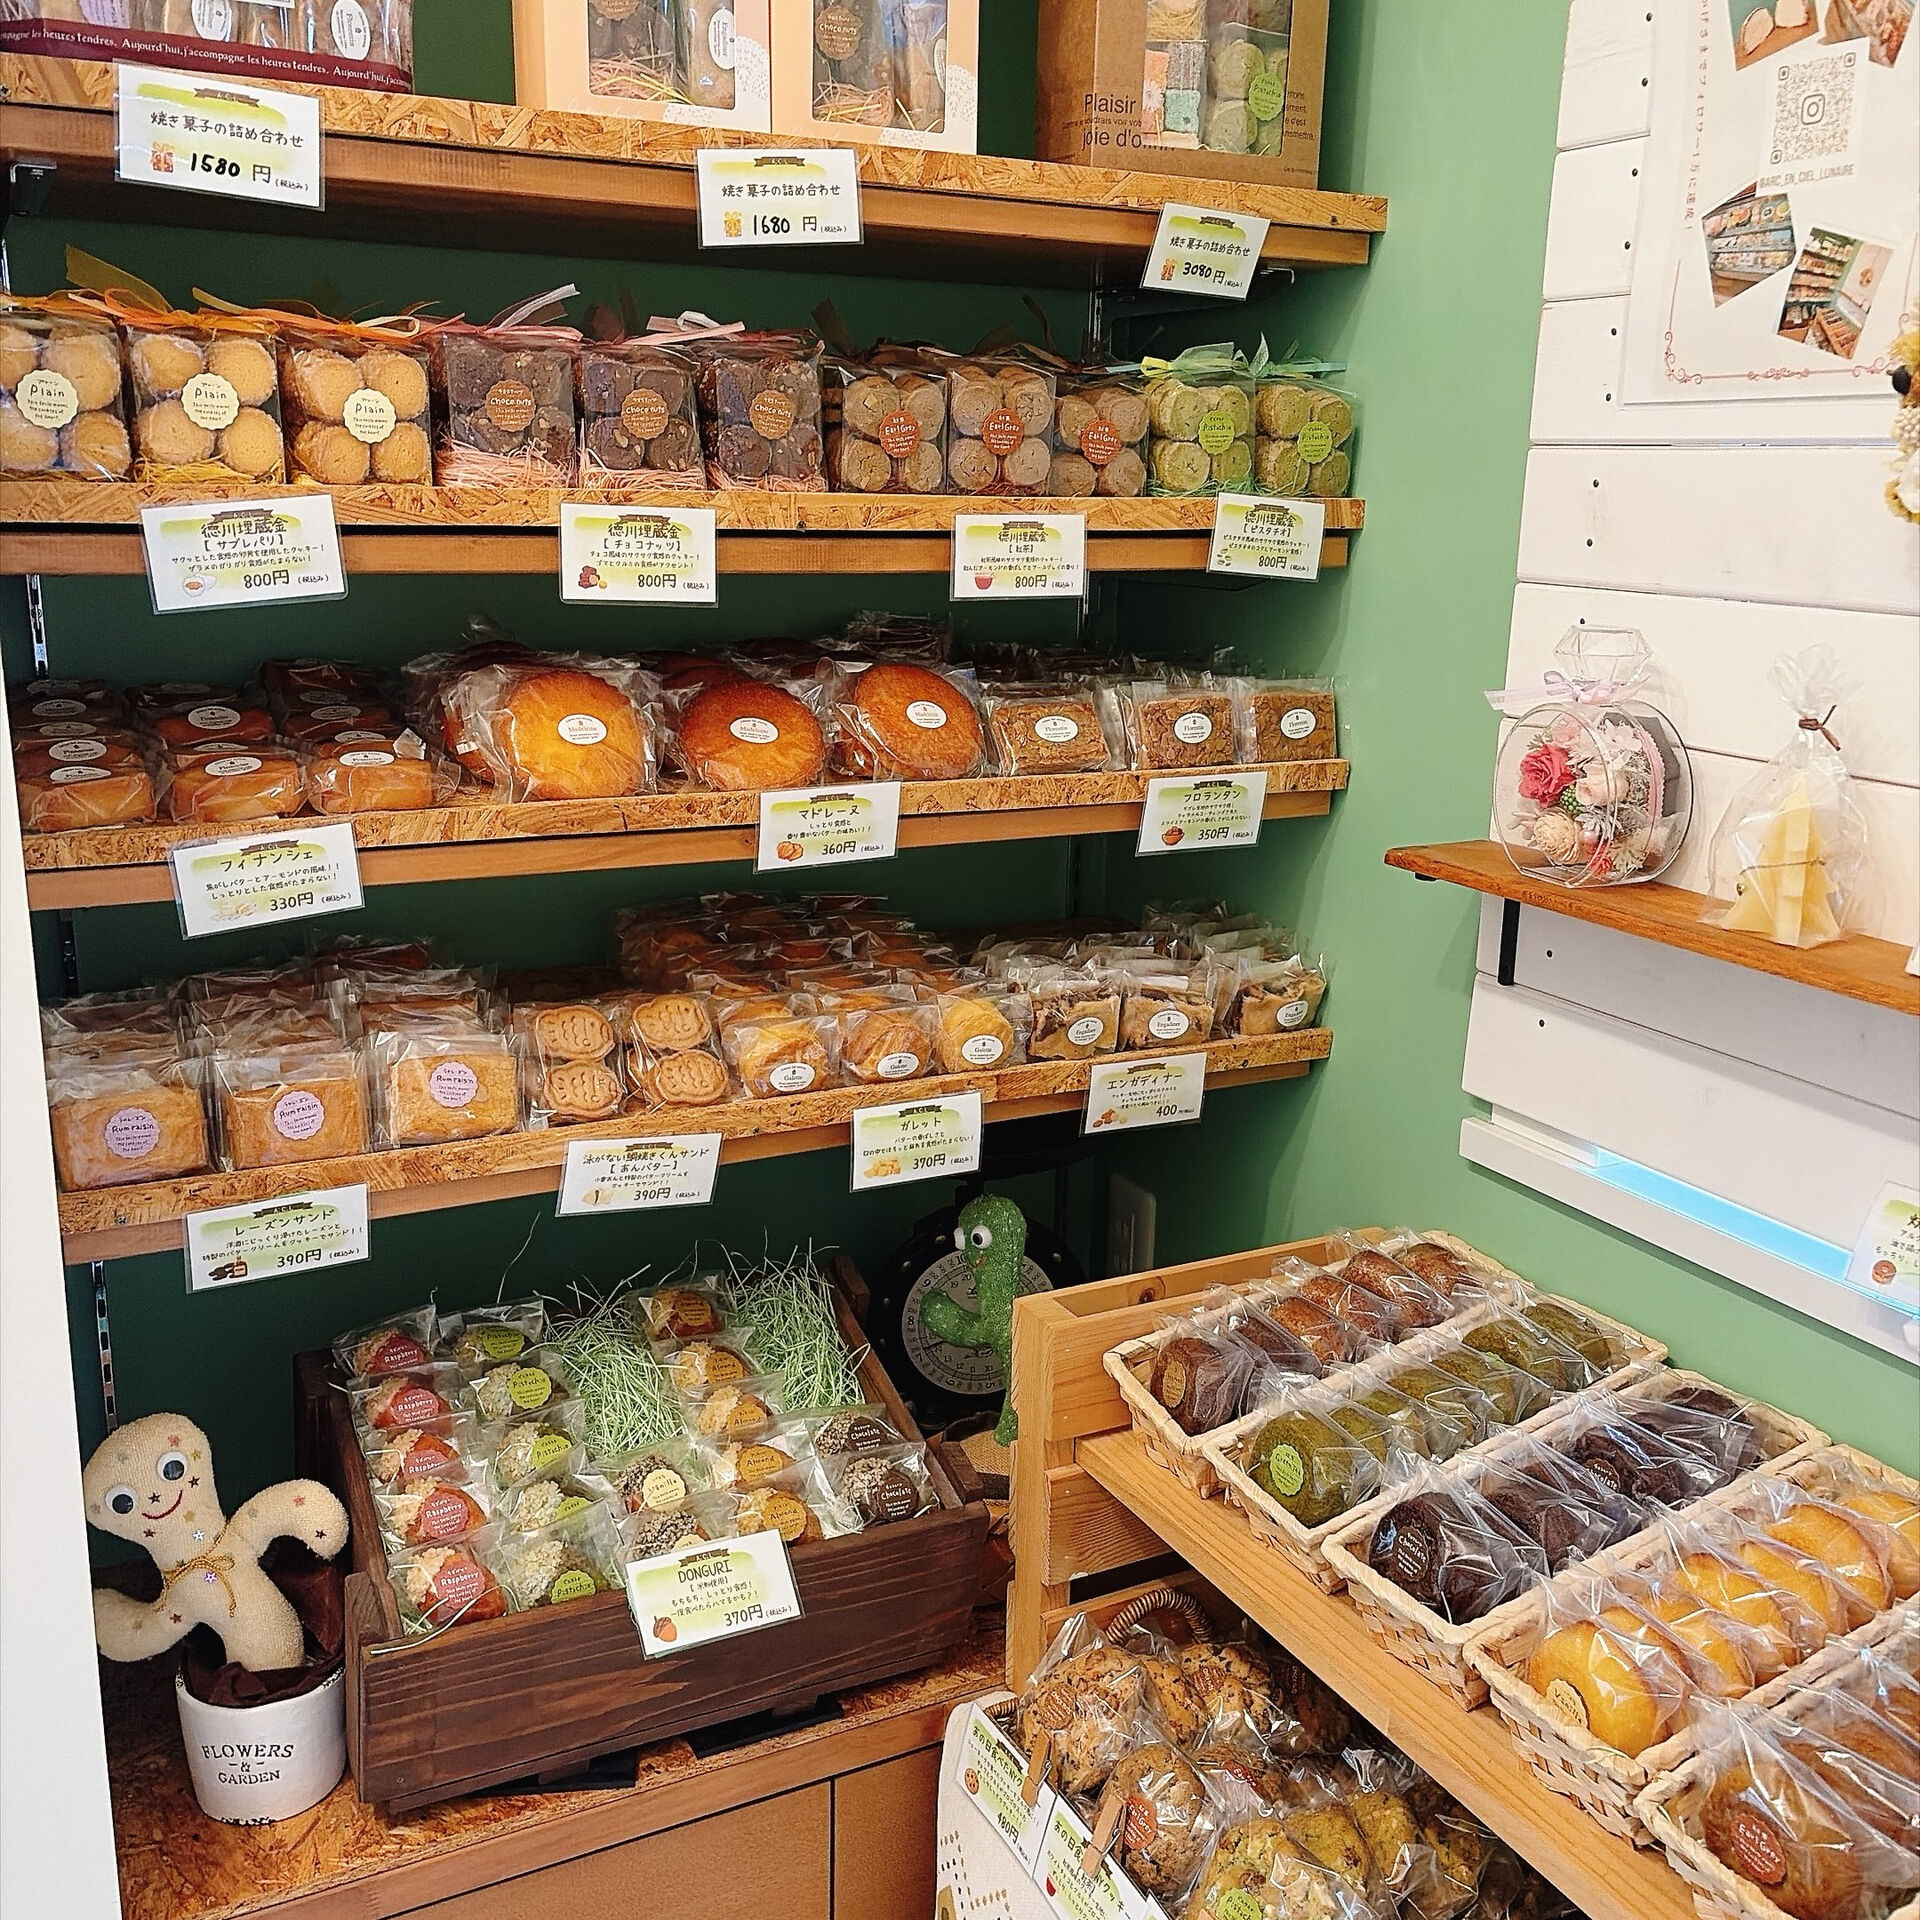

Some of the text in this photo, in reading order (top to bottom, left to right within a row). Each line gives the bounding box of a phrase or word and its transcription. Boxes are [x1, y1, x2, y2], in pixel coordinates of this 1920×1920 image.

[43, 29, 76, 42] heures
[77, 33, 118, 47] tendres.
[247, 52, 260, 65] les
[261, 56, 292, 70] heures
[293, 61, 330, 75] tendres.
[1084, 94, 1136, 115] Plaisir
[150, 111, 304, 148] 焼き菓子の詰め合わせ
[1083, 130, 1109, 151] joie
[191, 153, 241, 178] 1580
[253, 164, 271, 184] 円
[722, 183, 841, 198] 焼き菓子の詰め合わせ
[753, 214, 791, 235] 1680
[802, 216, 818, 232] 円
[1170, 236, 1251, 257] 焼き菓子の詰め合わせ
[1182, 261, 1212, 279] 3080
[1213, 270, 1226, 284] 円
[30, 386, 65, 398] Plain
[194, 387, 227, 400] Plain
[355, 402, 385, 415] Plain
[1245, 510, 1296, 528] 徳川埋蔵金
[201, 517, 289, 539] 徳川埋蔵金
[608, 523, 681, 540] 徳川埋蔵金
[998, 531, 1048, 543] 徳川埋蔵金
[1258, 555, 1288, 570] 800円
[243, 569, 290, 589] 800円
[637, 573, 677, 588] 800円
[1015, 574, 1047, 588] 800円
[1184, 790, 1241, 803] フロランタン
[799, 805, 860, 820] マドレーヌ
[1198, 827, 1230, 840] 350円
[821, 841, 857, 855] 360円
[220, 850, 314, 873] フィナンシェ
[270, 891, 314, 913] 330円
[1107, 1072, 1183, 1090] エンガディナー
[1156, 1104, 1178, 1117] 400
[901, 1117, 941, 1131] ガレット
[912, 1153, 946, 1170] 370円
[634, 1187, 671, 1200] 390円
[234, 1209, 335, 1236] レーズンサンド
[276, 1249, 322, 1268] 390円
[678, 1559, 732, 1583] DONGURI
[724, 1604, 764, 1627] 370円
[201, 1744, 294, 1759] FLOWERS
[240, 1761, 251, 1773] &
[218, 1770, 280, 1785] GARDEN
[997, 1813, 1019, 1845] 480円
